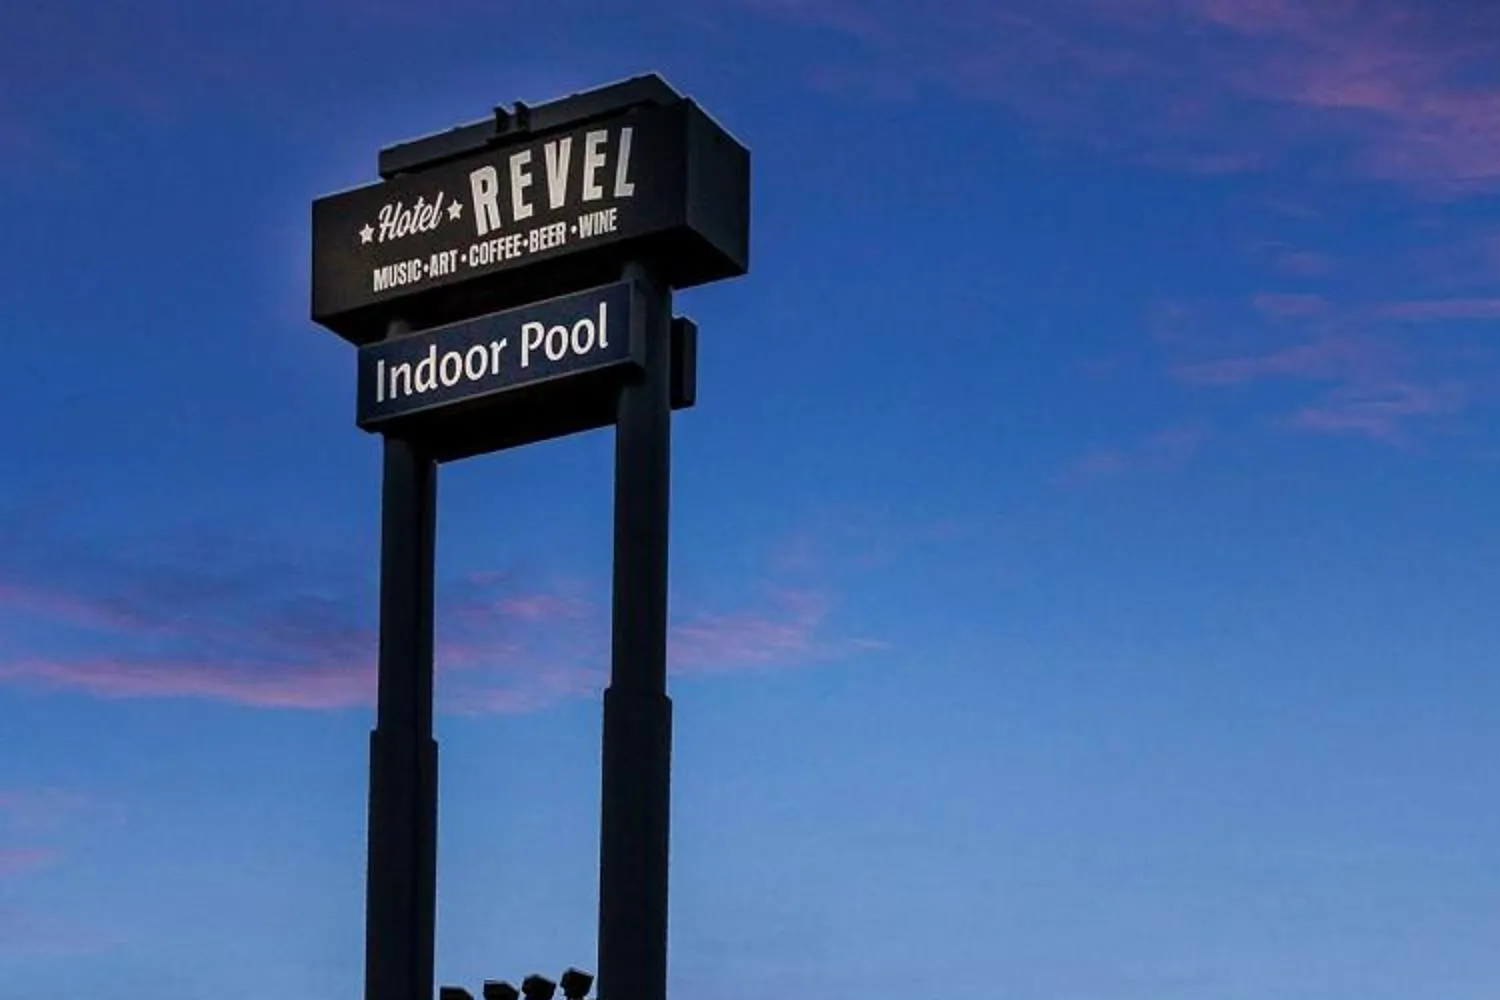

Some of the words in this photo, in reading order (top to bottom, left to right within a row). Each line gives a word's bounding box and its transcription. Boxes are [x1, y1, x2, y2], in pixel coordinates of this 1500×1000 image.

[378, 191, 444, 243] Hotel
[469, 127, 635, 236] REVEL
[373, 258, 421, 292] MUSIC
[429, 249, 458, 278] ART
[469, 233, 523, 267] COFFEE
[529, 221, 567, 253] BEER
[578, 207, 618, 239] WINE
[376, 337, 508, 403] Indoor
[521, 301, 609, 368] Pool
